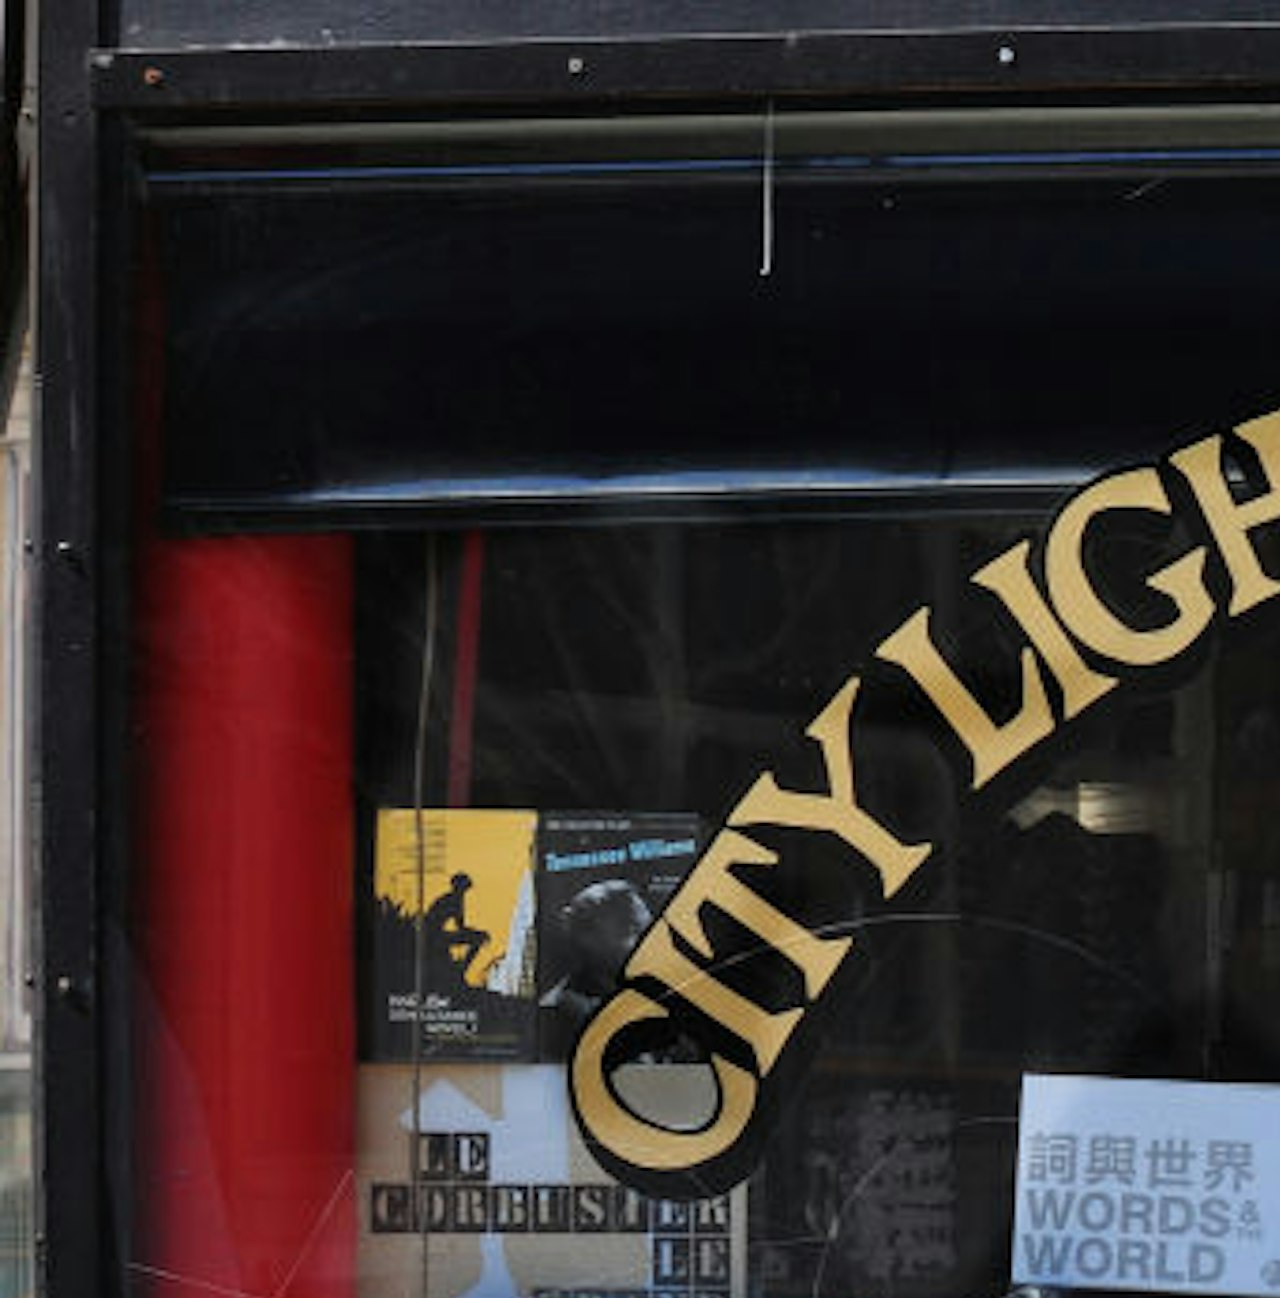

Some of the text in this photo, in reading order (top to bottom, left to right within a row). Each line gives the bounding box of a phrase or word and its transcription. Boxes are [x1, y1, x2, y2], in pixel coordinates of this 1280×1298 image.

[627, 836, 697, 862] Williams
[569, 676, 932, 1170] CITY
[419, 1135, 488, 1176] LE
[1026, 1131, 1257, 1194] 詞與世界
[1026, 1189, 1232, 1240] WORDS
[655, 1238, 731, 1282] LE
[1021, 1235, 1226, 1284] WORLD
